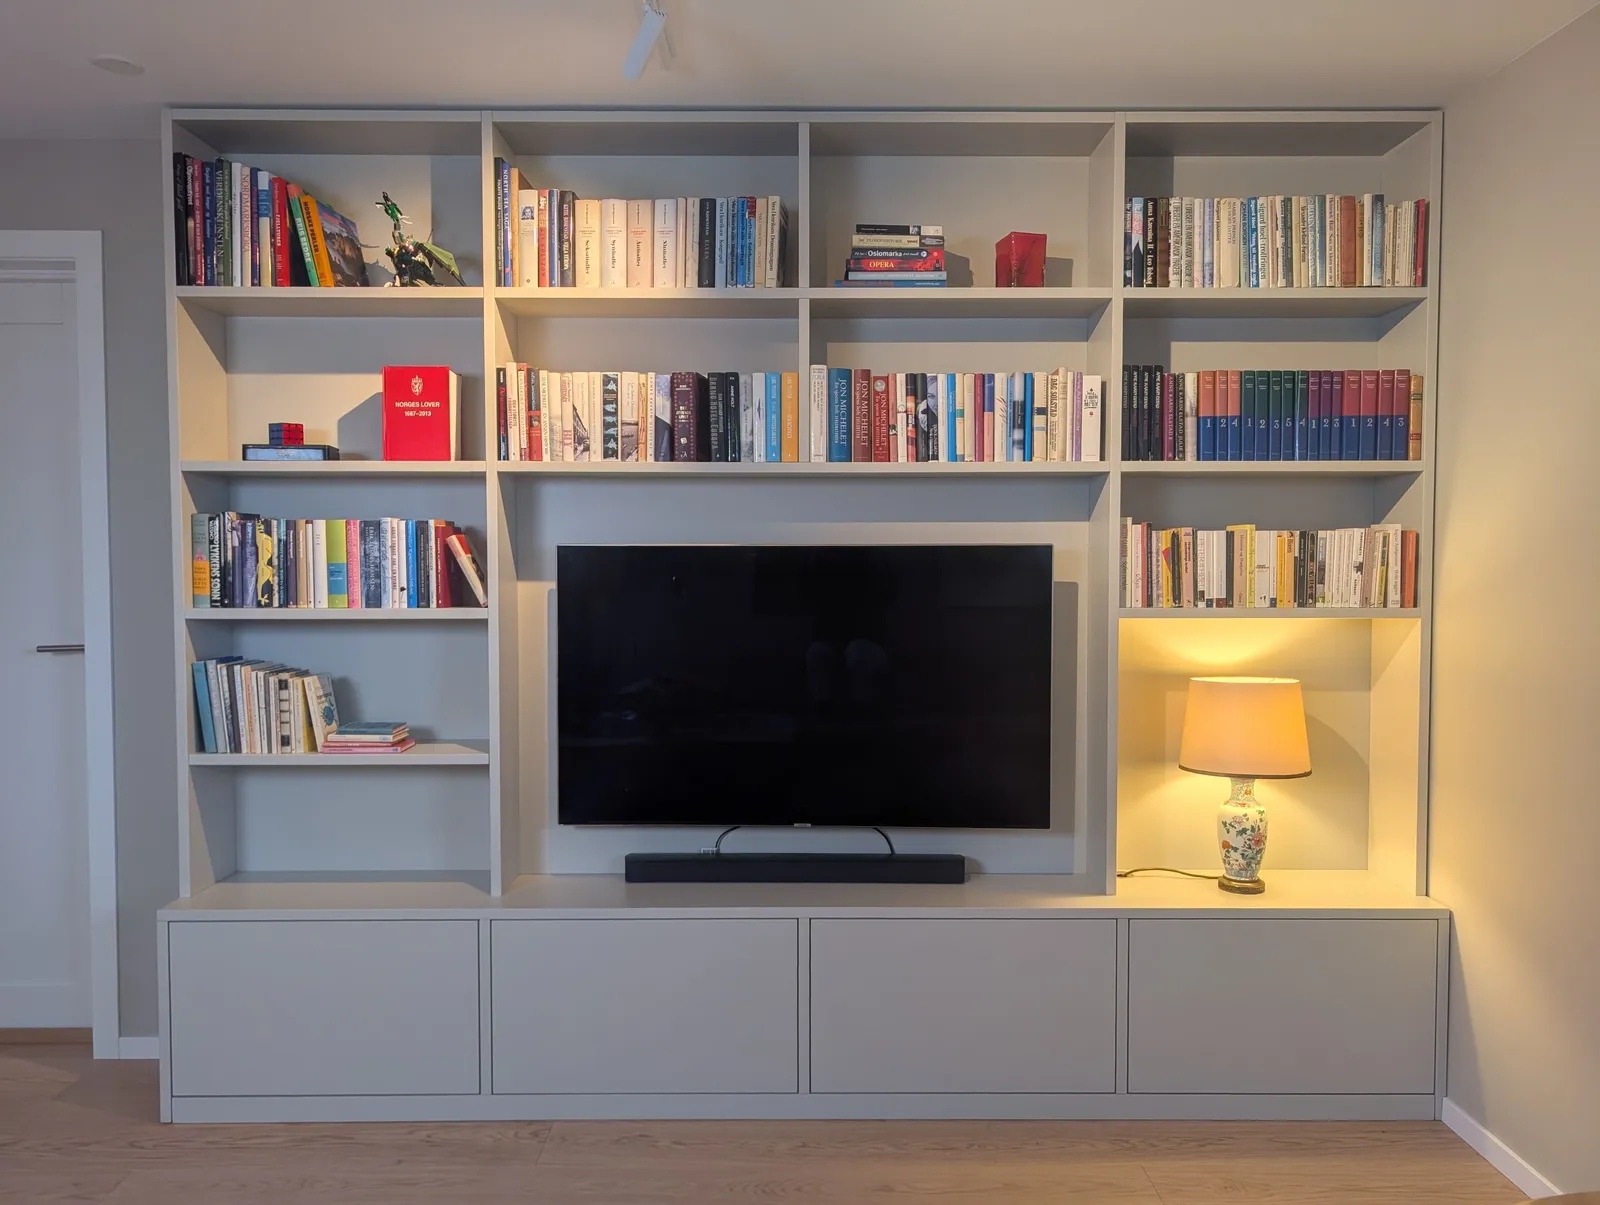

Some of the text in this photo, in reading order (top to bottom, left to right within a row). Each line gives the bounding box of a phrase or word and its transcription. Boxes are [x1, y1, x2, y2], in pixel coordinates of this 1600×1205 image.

[216, 170, 224, 257] VERDENSKUNSTEN
[303, 202, 319, 253] NORSKE PERLER
[295, 218, 311, 263] REIS BEDRE
[1259, 243, 1267, 280] trollringen
[838, 378, 847, 398] JON
[860, 380, 868, 398] JON
[1206, 419, 1211, 427] 1
[1220, 419, 1226, 427] 2
[1232, 418, 1238, 427] 4
[1247, 418, 1252, 427] 1
[1259, 419, 1266, 428] 2
[1274, 420, 1280, 429] 3
[1286, 418, 1292, 427] 5
[1299, 418, 1305, 427] 4
[1312, 420, 1316, 428] 1
[1323, 418, 1329, 427] 2
[1334, 419, 1340, 427] 3
[1351, 418, 1356, 427] 1
[1367, 418, 1373, 427] 2
[1383, 418, 1389, 427] 4
[1398, 418, 1404, 426] 3
[563, 430, 572, 448] BLY
[210, 544, 220, 600] LYKKENS SØNN
